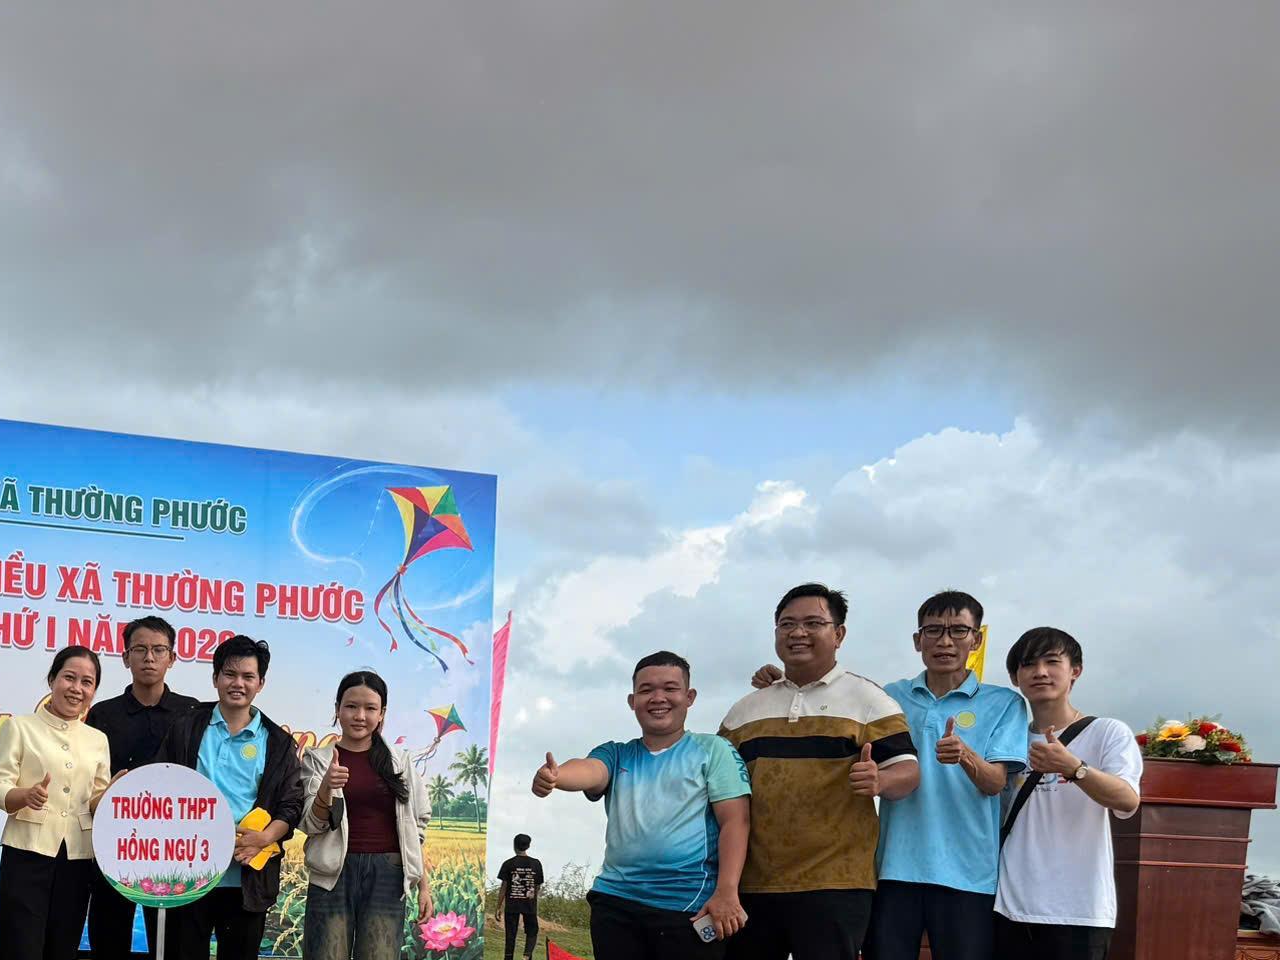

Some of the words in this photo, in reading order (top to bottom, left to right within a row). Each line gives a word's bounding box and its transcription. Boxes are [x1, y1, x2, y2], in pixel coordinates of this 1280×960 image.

[28, 484, 143, 524] THƯỜNG
[151, 497, 248, 534] PHƯỚC
[56, 562, 103, 603] XÃ
[112, 569, 246, 615] THƯỜNG
[255, 581, 365, 624] PHƯỚC
[46, 616, 57, 651] I
[112, 790, 173, 820] TRƯỜNG
[178, 797, 217, 820] THPT
[117, 828, 160, 861] HỒNG
[164, 834, 198, 868] NGỰ
[201, 839, 209, 861] 3
